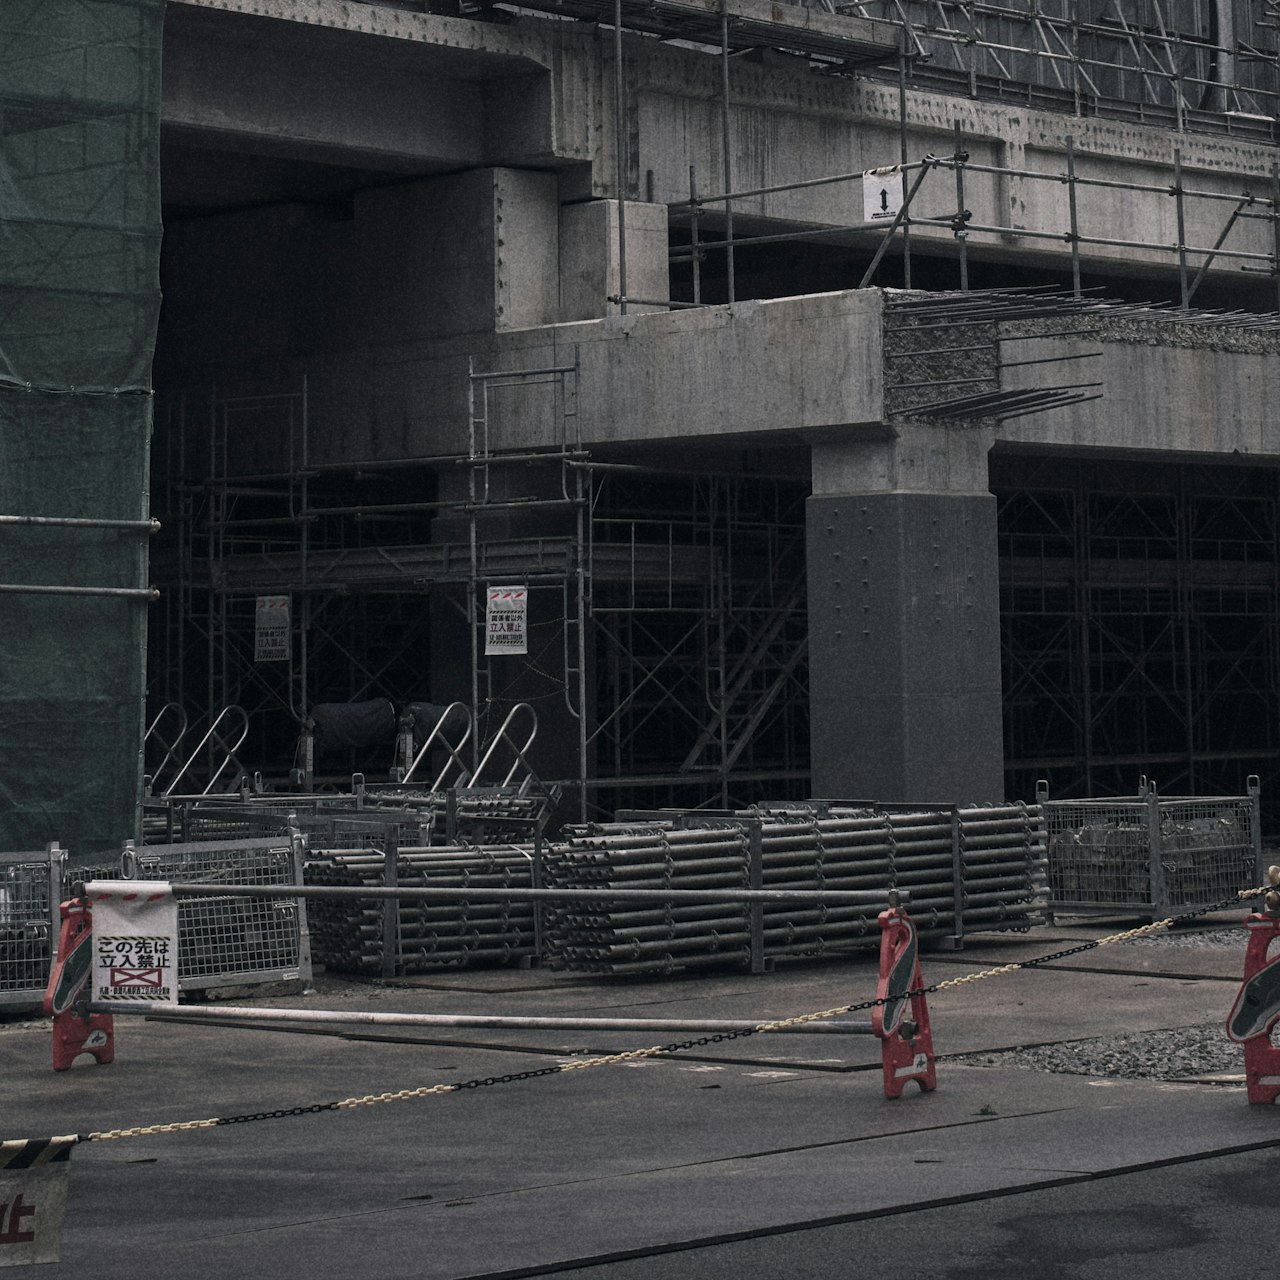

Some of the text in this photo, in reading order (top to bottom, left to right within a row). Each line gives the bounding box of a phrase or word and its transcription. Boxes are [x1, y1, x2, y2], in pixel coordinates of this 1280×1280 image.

[490, 623, 522, 632] 立入禁止
[98, 940, 169, 955] この先は
[99, 954, 171, 968] 立入禁止
